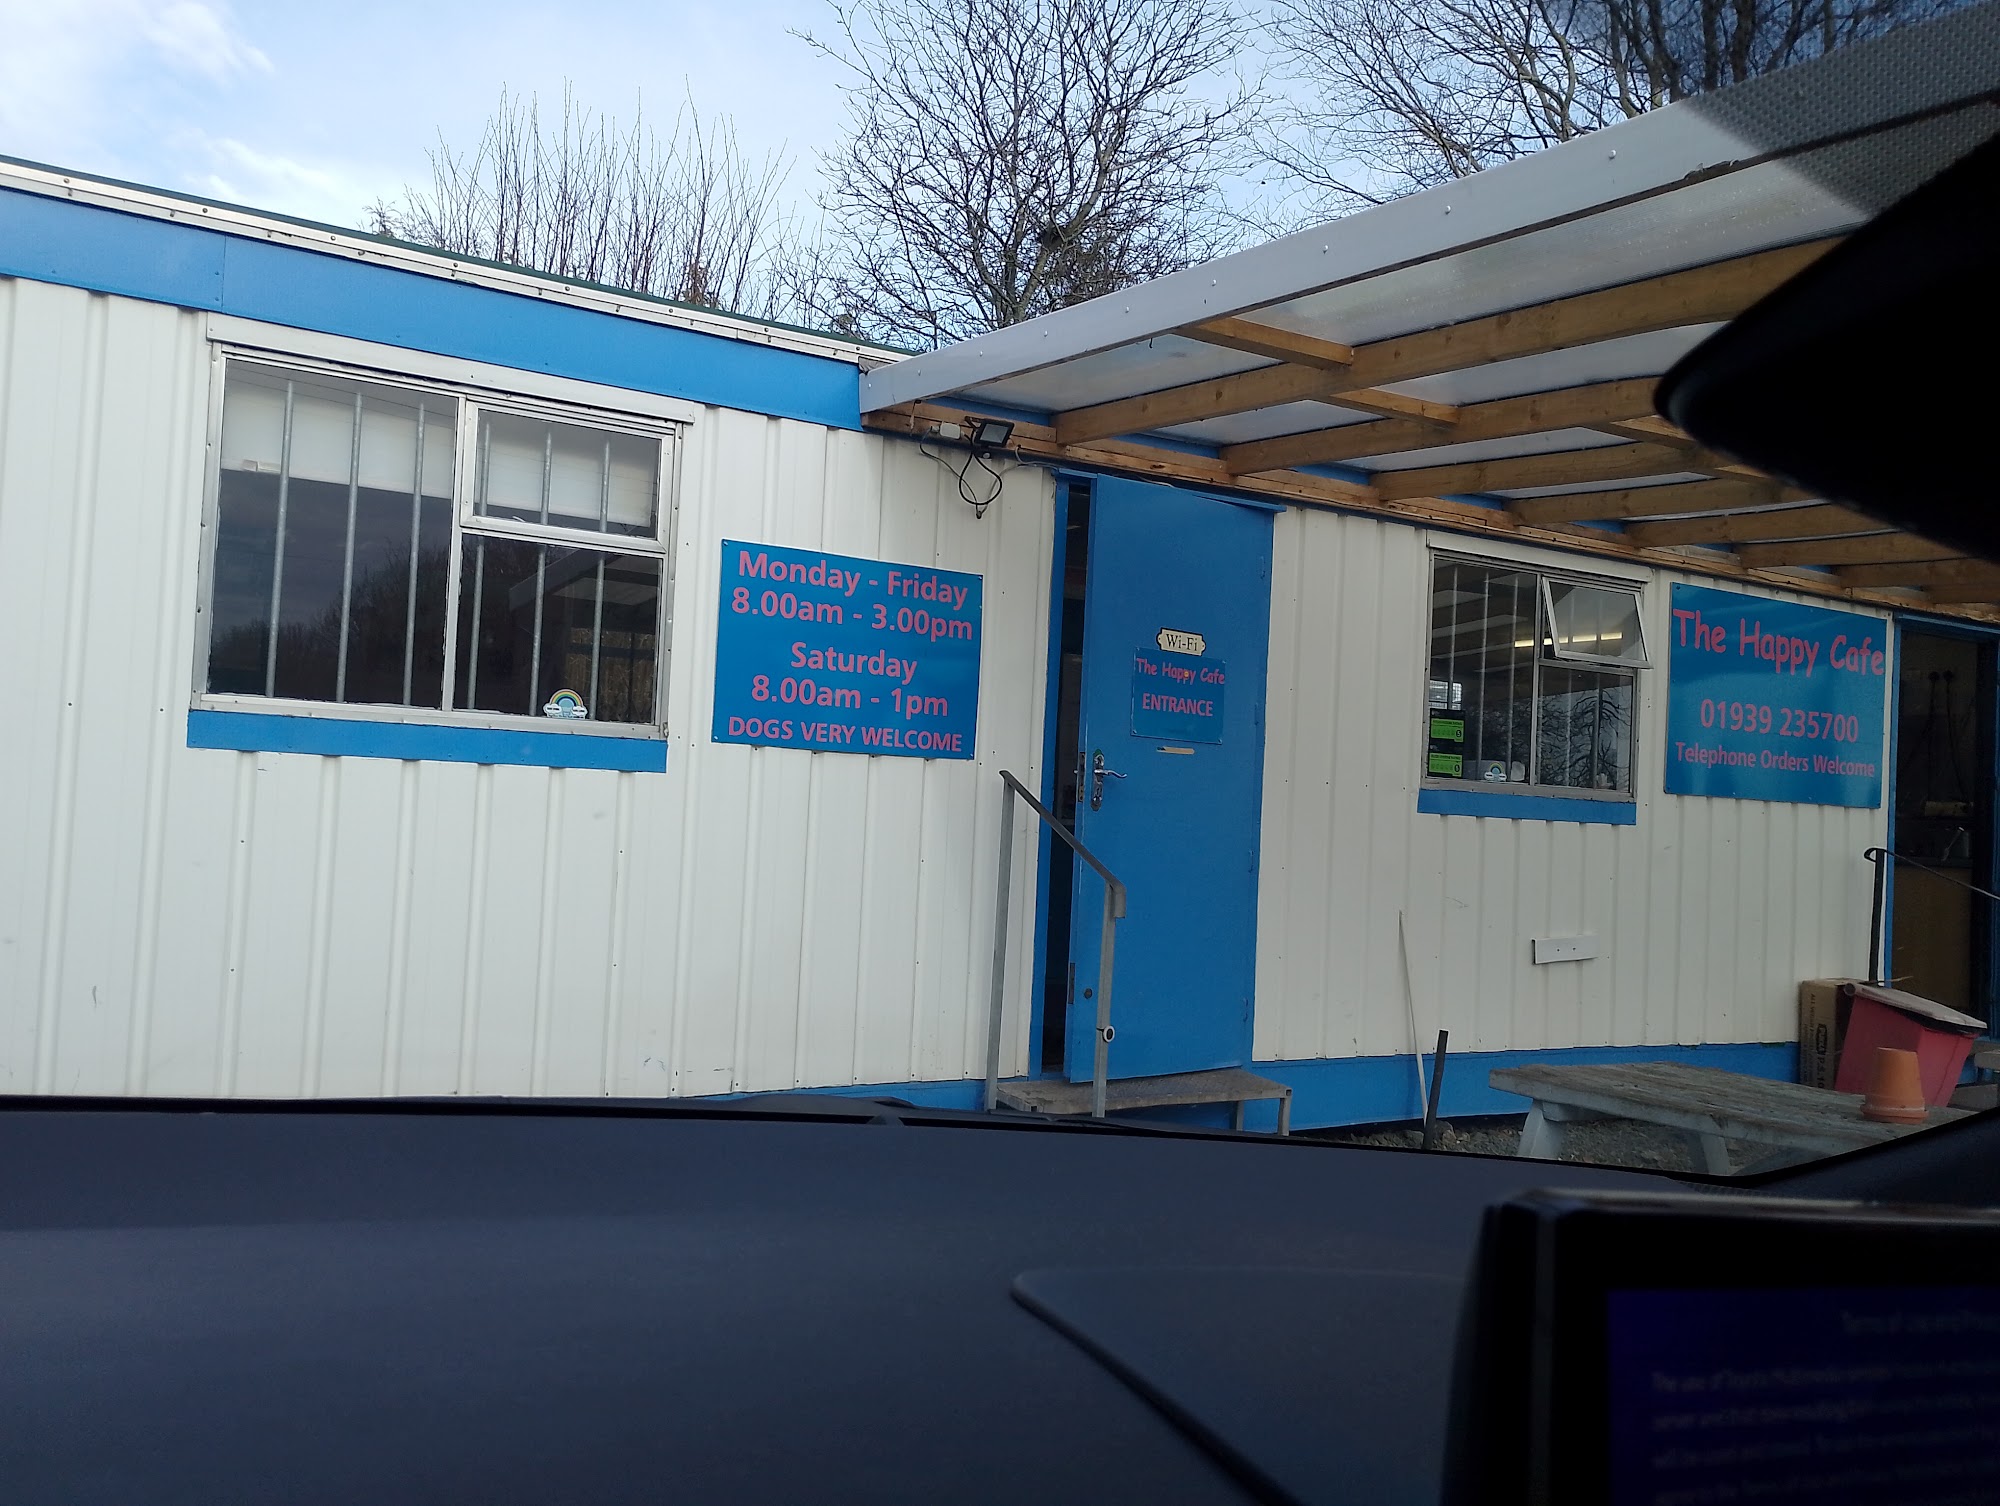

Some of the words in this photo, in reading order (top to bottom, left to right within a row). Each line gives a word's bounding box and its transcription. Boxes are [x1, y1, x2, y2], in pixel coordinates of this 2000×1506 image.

[738, 550, 861, 597] Monday
[887, 571, 968, 610] Friday
[731, 587, 843, 625] 8.00am
[871, 604, 973, 642] 3.00pm
[790, 641, 918, 685] Saturday
[1166, 633, 1198, 651] Wi-Fi
[1673, 608, 1727, 653] The
[1739, 618, 1820, 678] Happy
[1830, 635, 1884, 676] Cafe
[1136, 657, 1157, 676] The
[1162, 661, 1197, 685] Happy
[1200, 667, 1225, 684] Cafe
[751, 675, 861, 709] 8.00am
[891, 688, 948, 720] 1pm
[1142, 692, 1214, 717] ENTRANCE
[728, 716, 794, 740] DOGS
[800, 722, 856, 744] VERY
[861, 726, 962, 752] WELCOME
[1700, 698, 1772, 734] 01939
[1779, 707, 1859, 743] 235700
[1675, 741, 1757, 769] Telephone
[1760, 750, 1809, 772] Orders
[1813, 754, 1875, 778] Welcome
